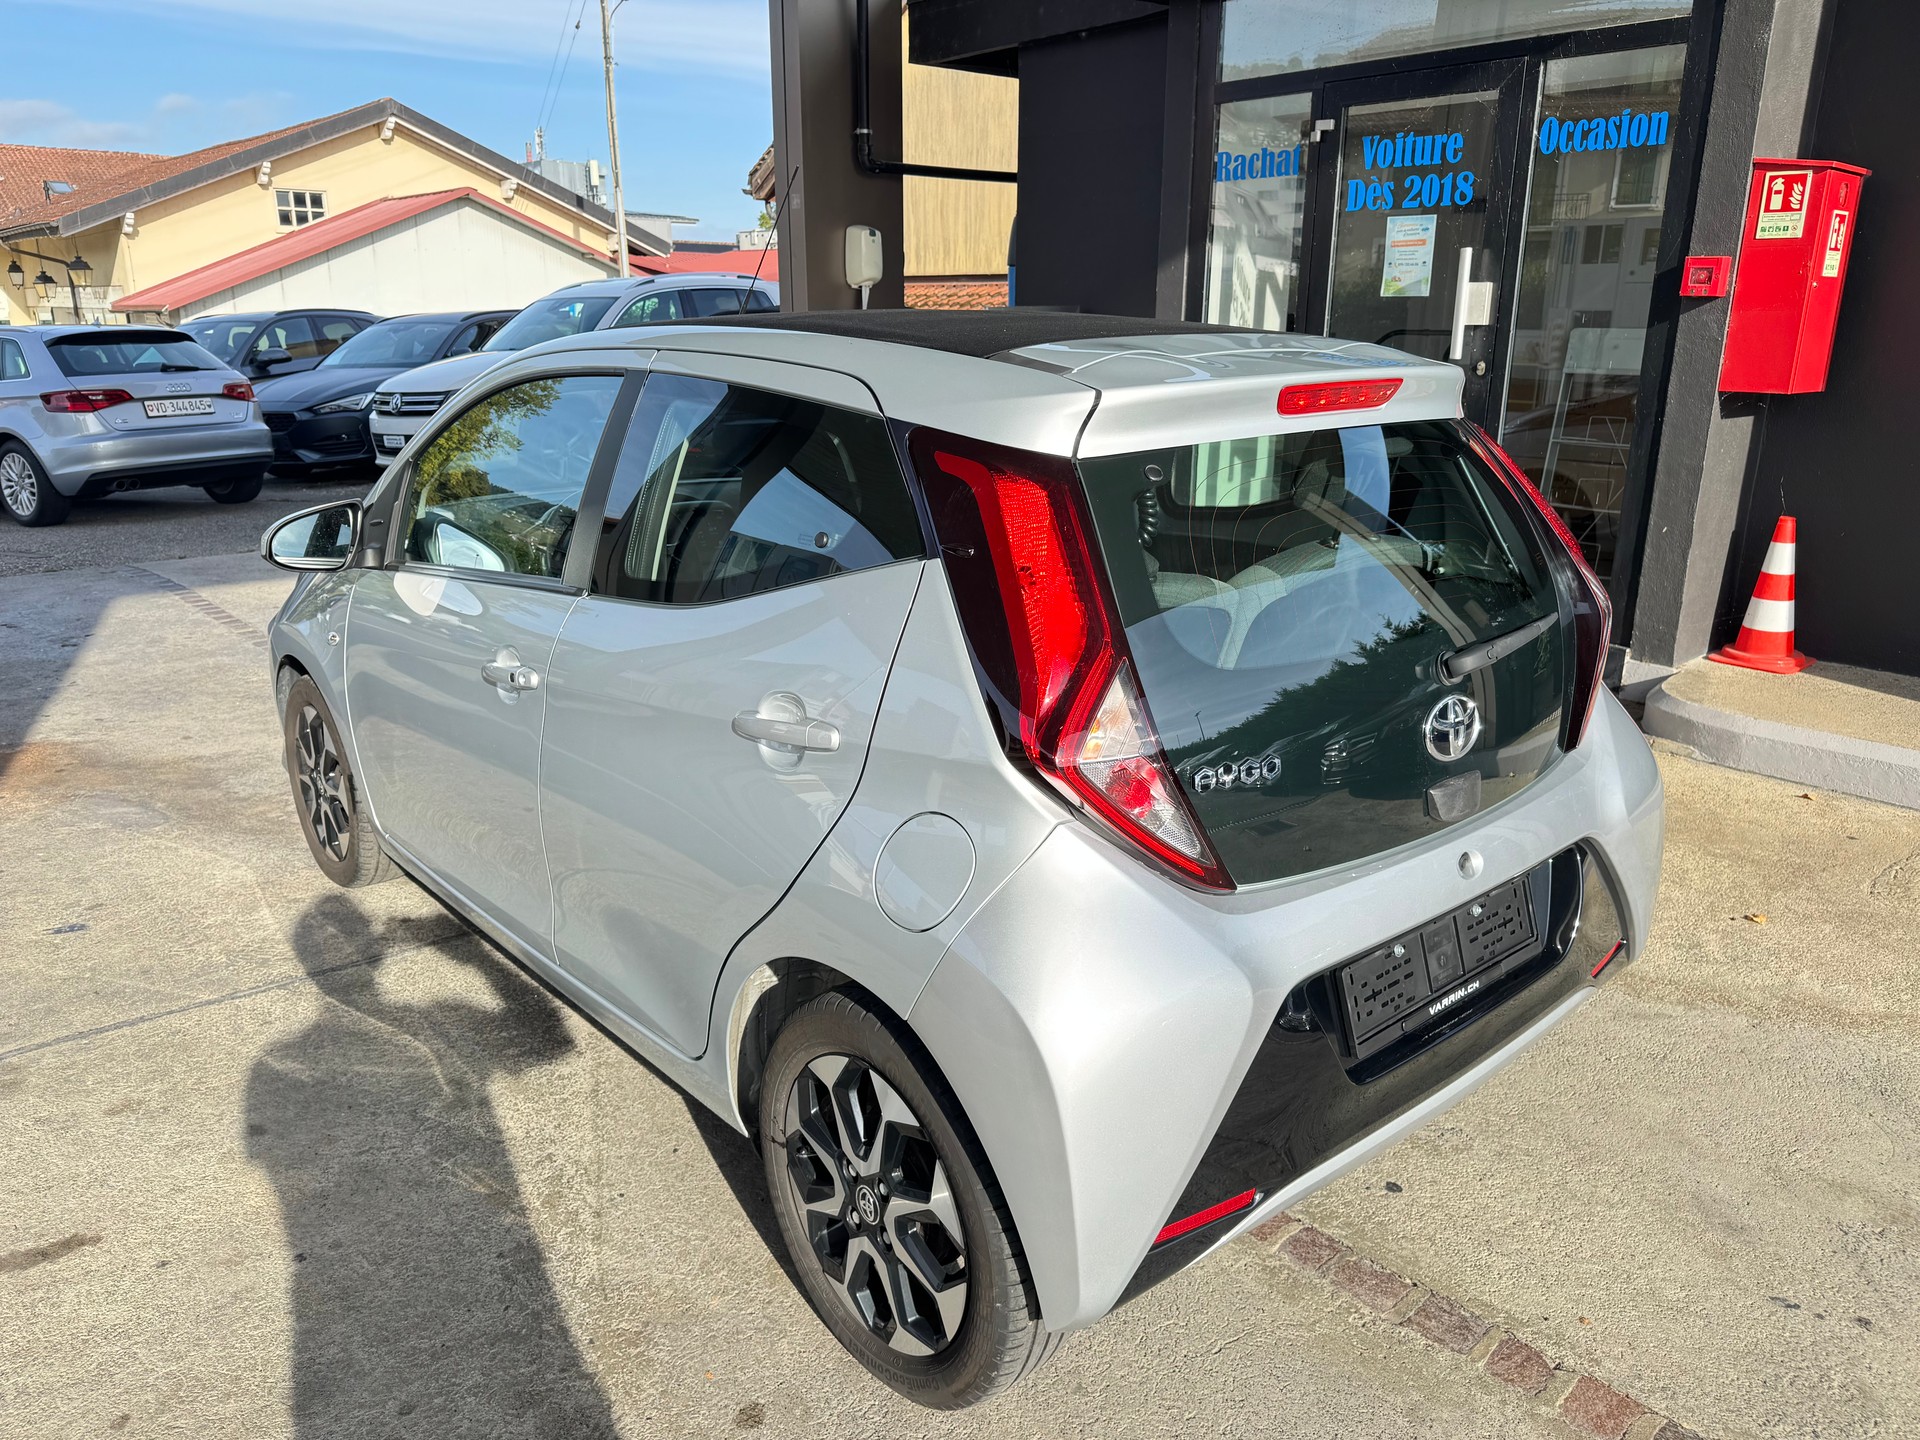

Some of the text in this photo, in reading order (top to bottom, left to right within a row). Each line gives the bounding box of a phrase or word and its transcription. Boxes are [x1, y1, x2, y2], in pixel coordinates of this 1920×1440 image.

[1362, 131, 1464, 170] Voiture
[1539, 108, 1669, 155] Occasion
[1216, 143, 1301, 182] Rachat
[1345, 171, 1475, 212] Dès 2018
[1193, 754, 1282, 793] AYGO
[1428, 980, 1480, 1015] VARRIN.CH
